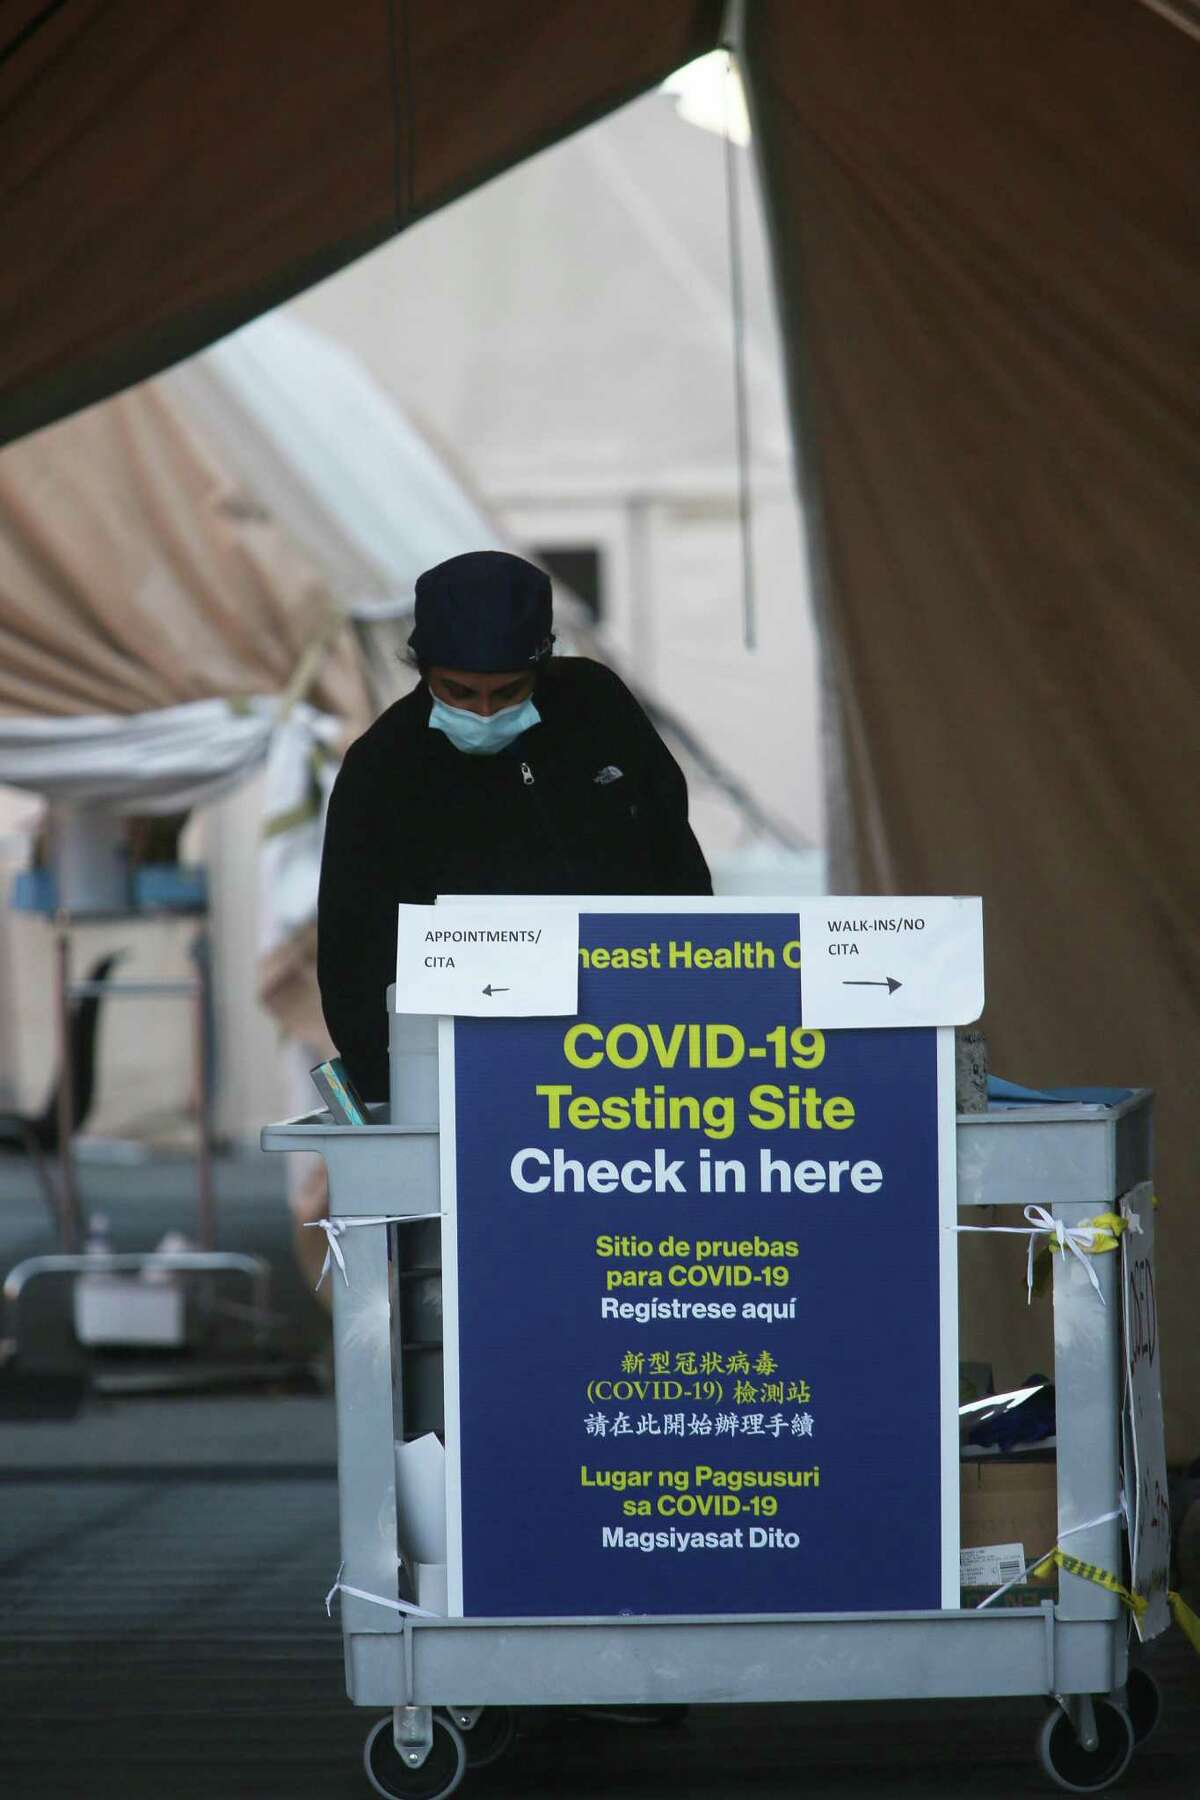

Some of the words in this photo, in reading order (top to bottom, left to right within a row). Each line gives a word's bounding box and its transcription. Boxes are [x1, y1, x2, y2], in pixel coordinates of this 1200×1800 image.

[424, 929, 542, 944] APPOINTMENTS/
[827, 917, 925, 933] WALK-INS/NO
[424, 956, 456, 968] CITA
[668, 941, 775, 969] Health
[828, 943, 860, 956] CITA
[563, 1023, 826, 1070] COVID-19
[535, 1084, 735, 1140] Testing
[748, 1084, 856, 1130] Site
[510, 1147, 687, 1194] Check
[699, 1148, 746, 1193] in
[760, 1148, 883, 1194] here
[596, 1235, 654, 1257] Sitio
[658, 1235, 691, 1257] de
[695, 1235, 799, 1262] pruebas
[606, 1270, 663, 1291] para
[668, 1264, 789, 1287] COVID-19
[601, 1297, 737, 1324] Regístrese
[741, 1297, 797, 1324] aquí
[621, 1350, 779, 1376] 新型冠狀病毒
[587, 1380, 723, 1404] (COVID-19)
[580, 1465, 653, 1492] Lugar
[658, 1470, 689, 1492] ng
[695, 1465, 820, 1492] Pagsusuri
[623, 1499, 652, 1516] sa
[656, 1494, 778, 1517] COVID-19
[602, 1526, 744, 1553] Magsiyasat
[749, 1527, 800, 1549] Dito
